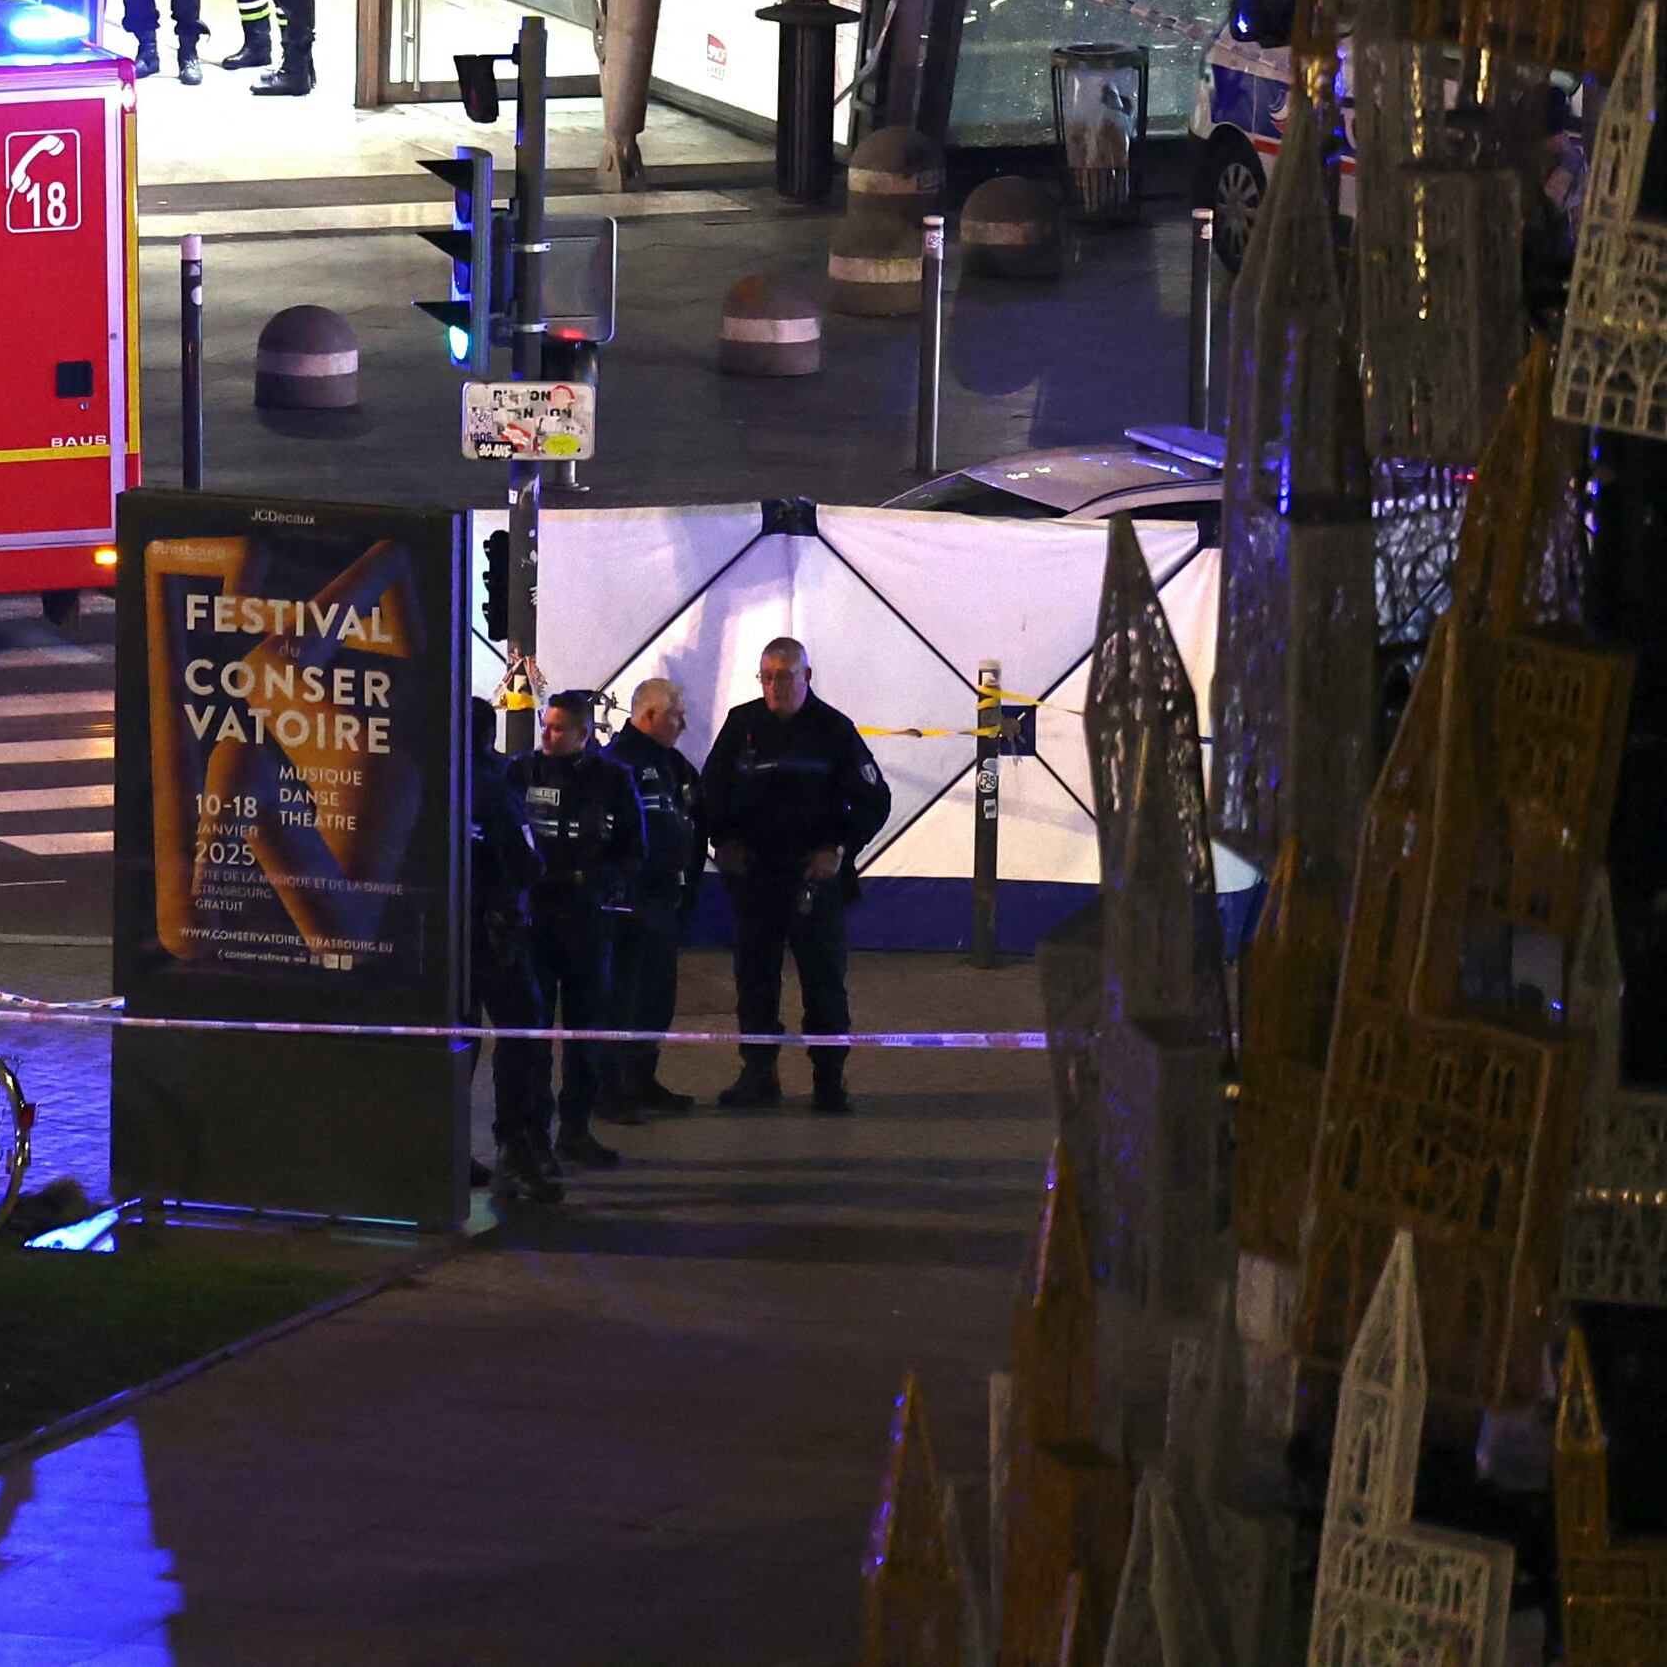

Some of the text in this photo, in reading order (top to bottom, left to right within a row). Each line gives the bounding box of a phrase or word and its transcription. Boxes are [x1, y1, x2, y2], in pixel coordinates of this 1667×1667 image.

[25, 181, 67, 228] 18
[51, 435, 107, 448] BAUS
[251, 509, 315, 525] JCDecaux
[186, 594, 392, 644] FESTIVAL
[278, 639, 301, 658] du
[184, 659, 392, 708] CONSER
[183, 703, 392, 754] VATOIRE
[279, 765, 363, 787] MUSIQUE
[195, 793, 258, 818] 10-18
[279, 788, 340, 807] DANSE
[196, 822, 258, 838] JANVIER
[194, 841, 257, 866] 2025
[223, 870, 238, 881] DE
[242, 871, 257, 882] LA
[328, 879, 342, 890] DE
[347, 879, 362, 891] LA
[364, 881, 404, 895] DANSE
[195, 898, 243, 912] GRATUIT
